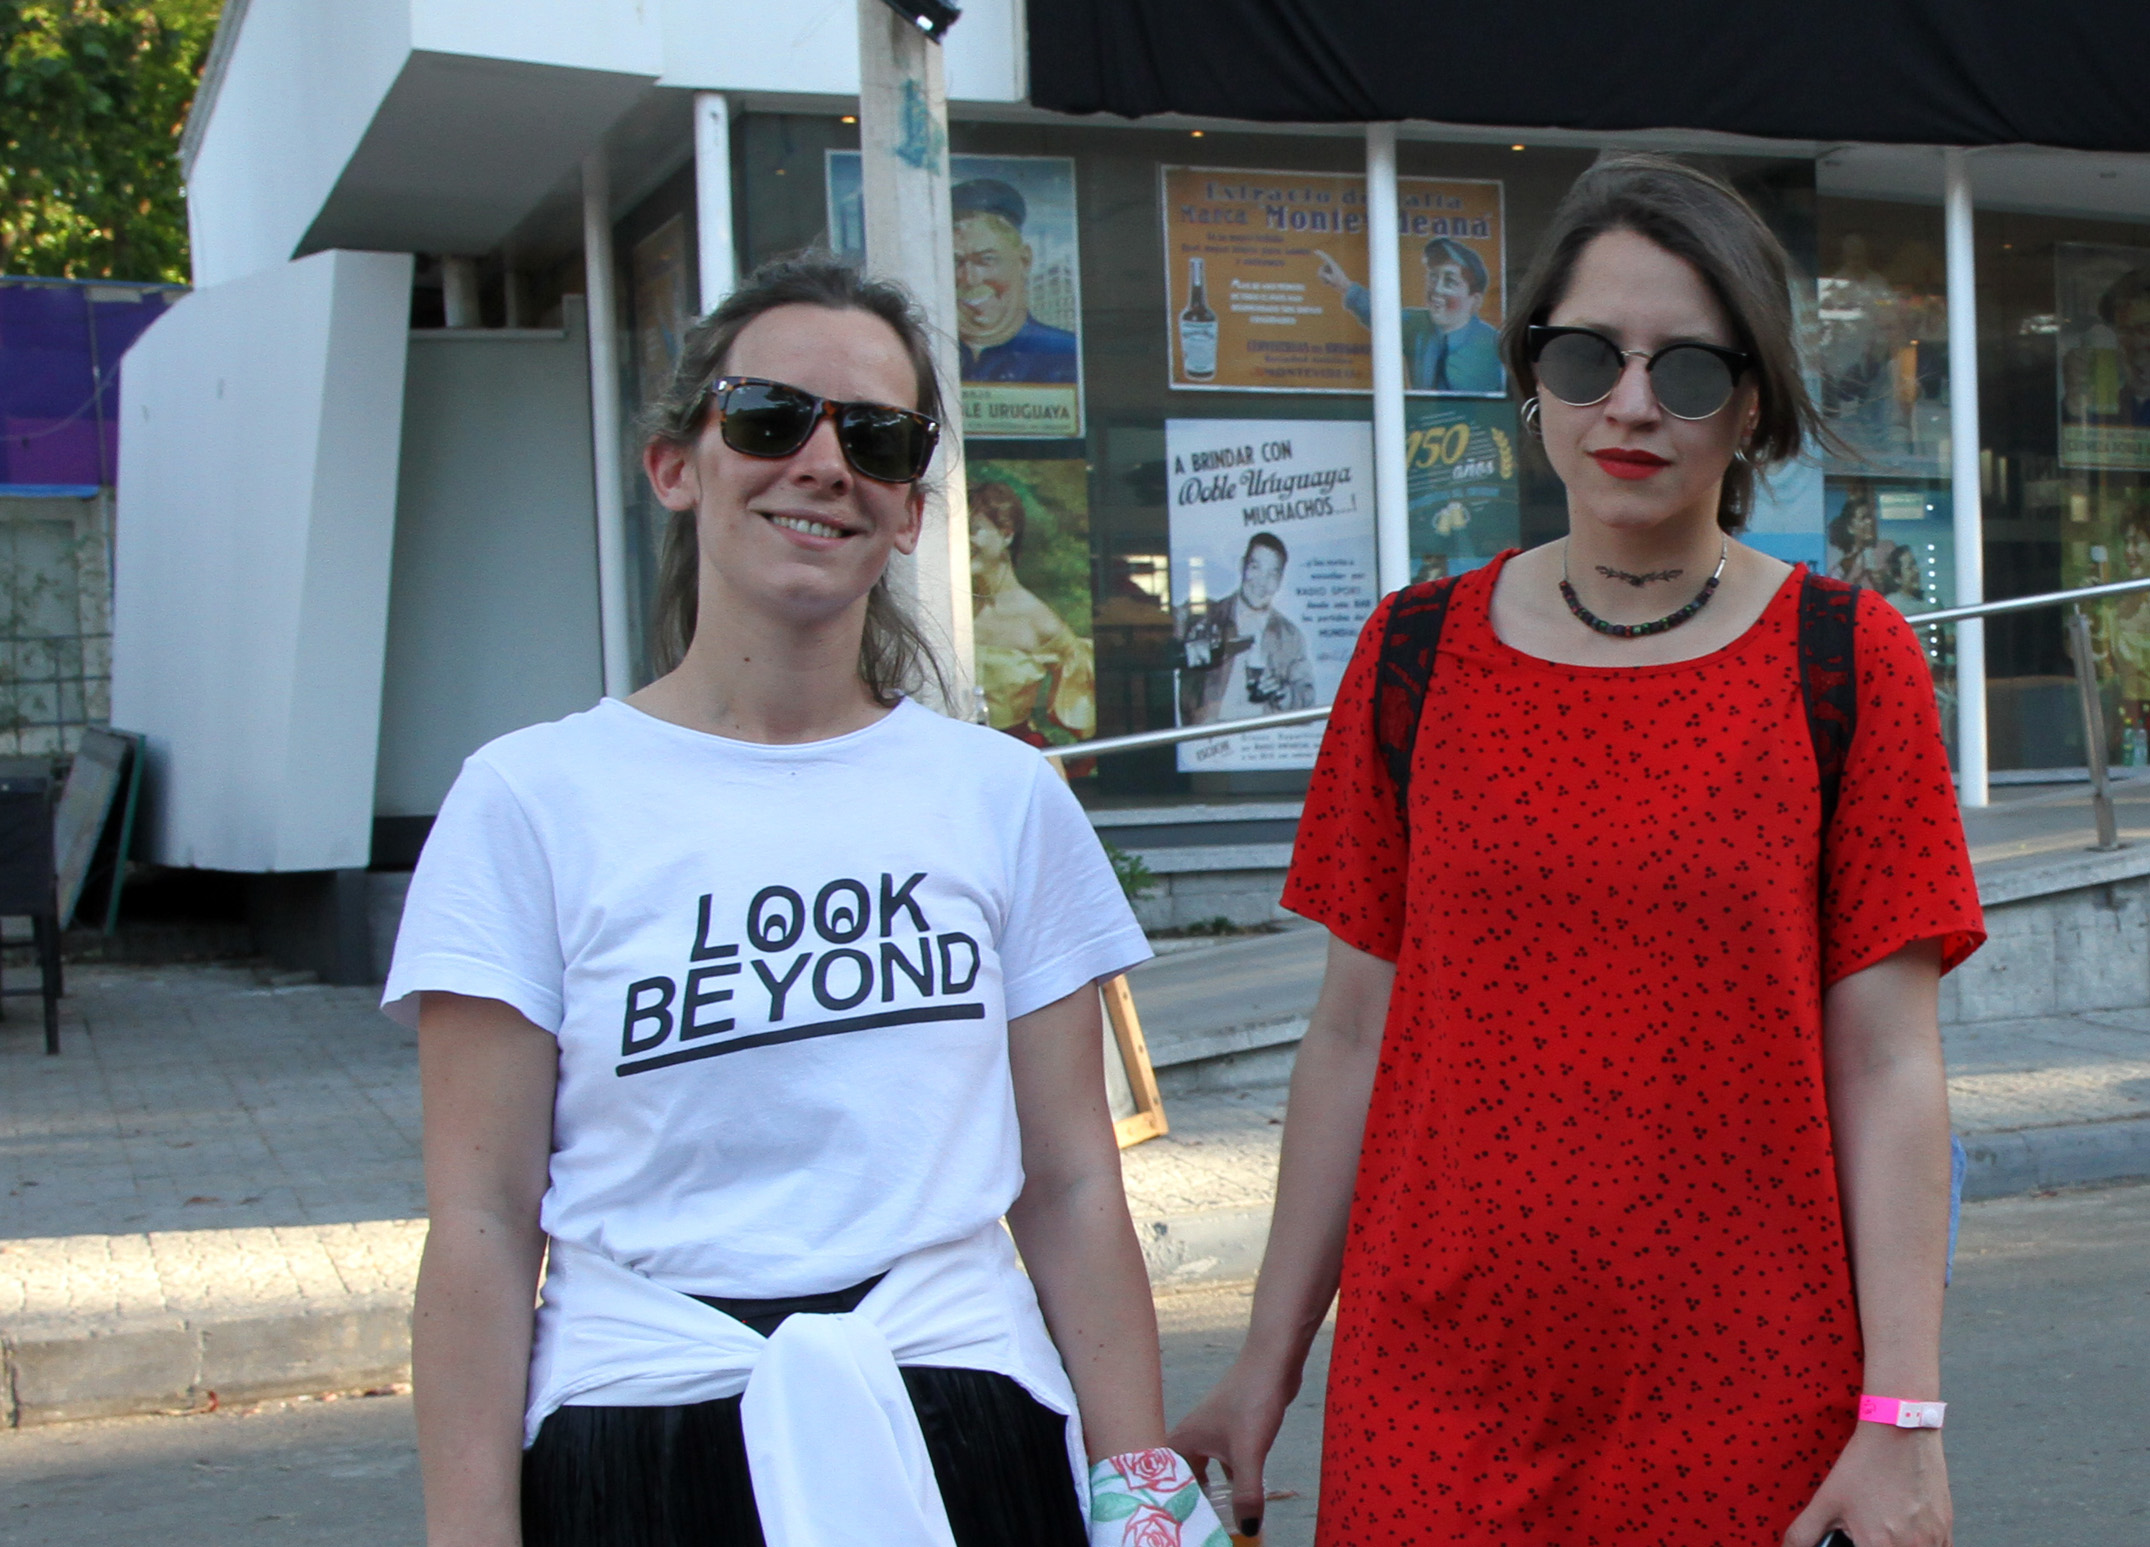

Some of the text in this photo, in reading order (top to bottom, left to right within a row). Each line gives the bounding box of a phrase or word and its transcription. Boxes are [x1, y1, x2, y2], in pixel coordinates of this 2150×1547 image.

[1206, 181, 1332, 203] Extracto
[1404, 192, 1463, 209] alta
[1181, 204, 1247, 225] Marca
[989, 403, 1071, 419] URUGUAYA
[1175, 439, 1292, 475] A BRINDAR CON
[1406, 423, 1470, 470] 150
[1178, 467, 1353, 506] Doble Uruguaya
[690, 872, 928, 963] LOOK
[621, 931, 980, 1057] BEYOND
